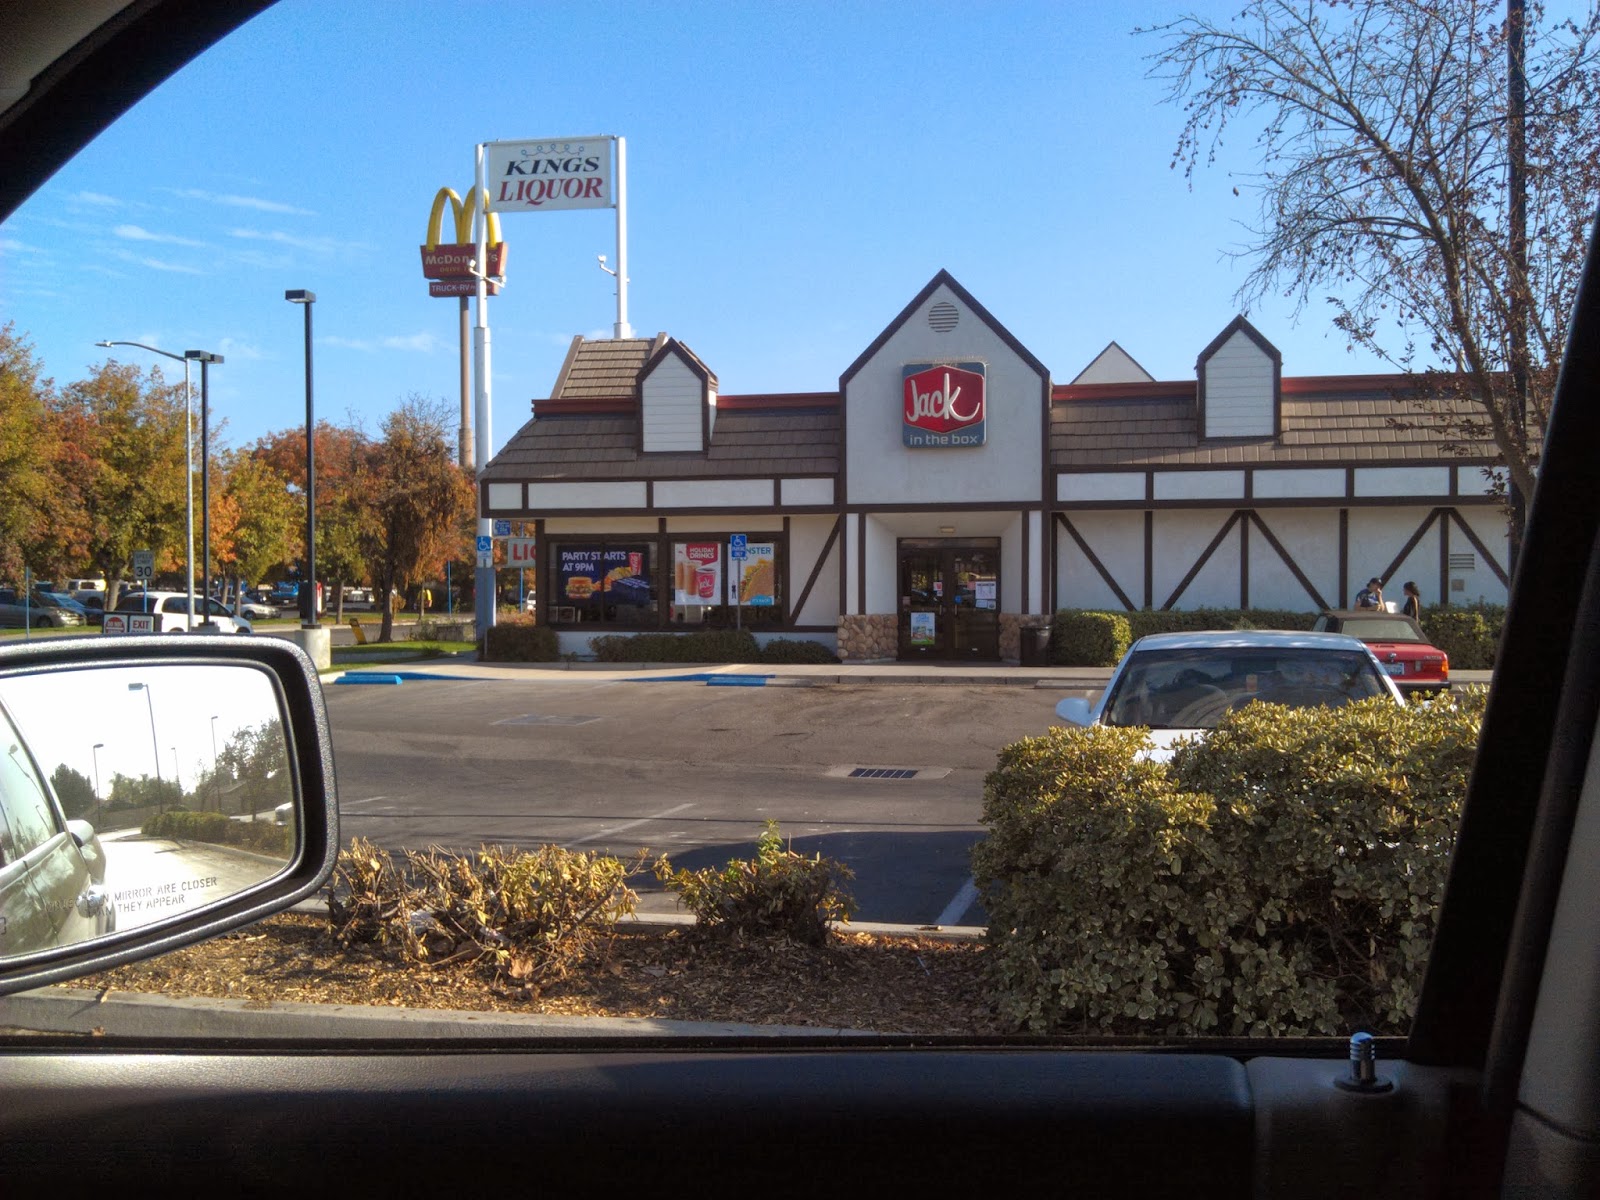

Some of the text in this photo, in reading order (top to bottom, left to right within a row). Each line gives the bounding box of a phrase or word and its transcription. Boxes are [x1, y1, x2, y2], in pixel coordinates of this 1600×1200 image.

[505, 156, 600, 176] KINGS
[496, 177, 604, 206] LIQUOR
[426, 253, 498, 265] McDon's
[906, 372, 981, 422] Jack
[910, 434, 978, 445] in the box
[562, 551, 590, 561] PARTY
[746, 546, 772, 555] NSTER
[136, 566, 152, 577] 30
[563, 562, 595, 572] AT 9PM
[132, 620, 150, 630] EXIT
[114, 888, 153, 903] MIRROR
[156, 882, 177, 895] ARE
[181, 876, 218, 891] CLOSER
[117, 900, 142, 913] THEY
[145, 893, 185, 910] APPEAR
